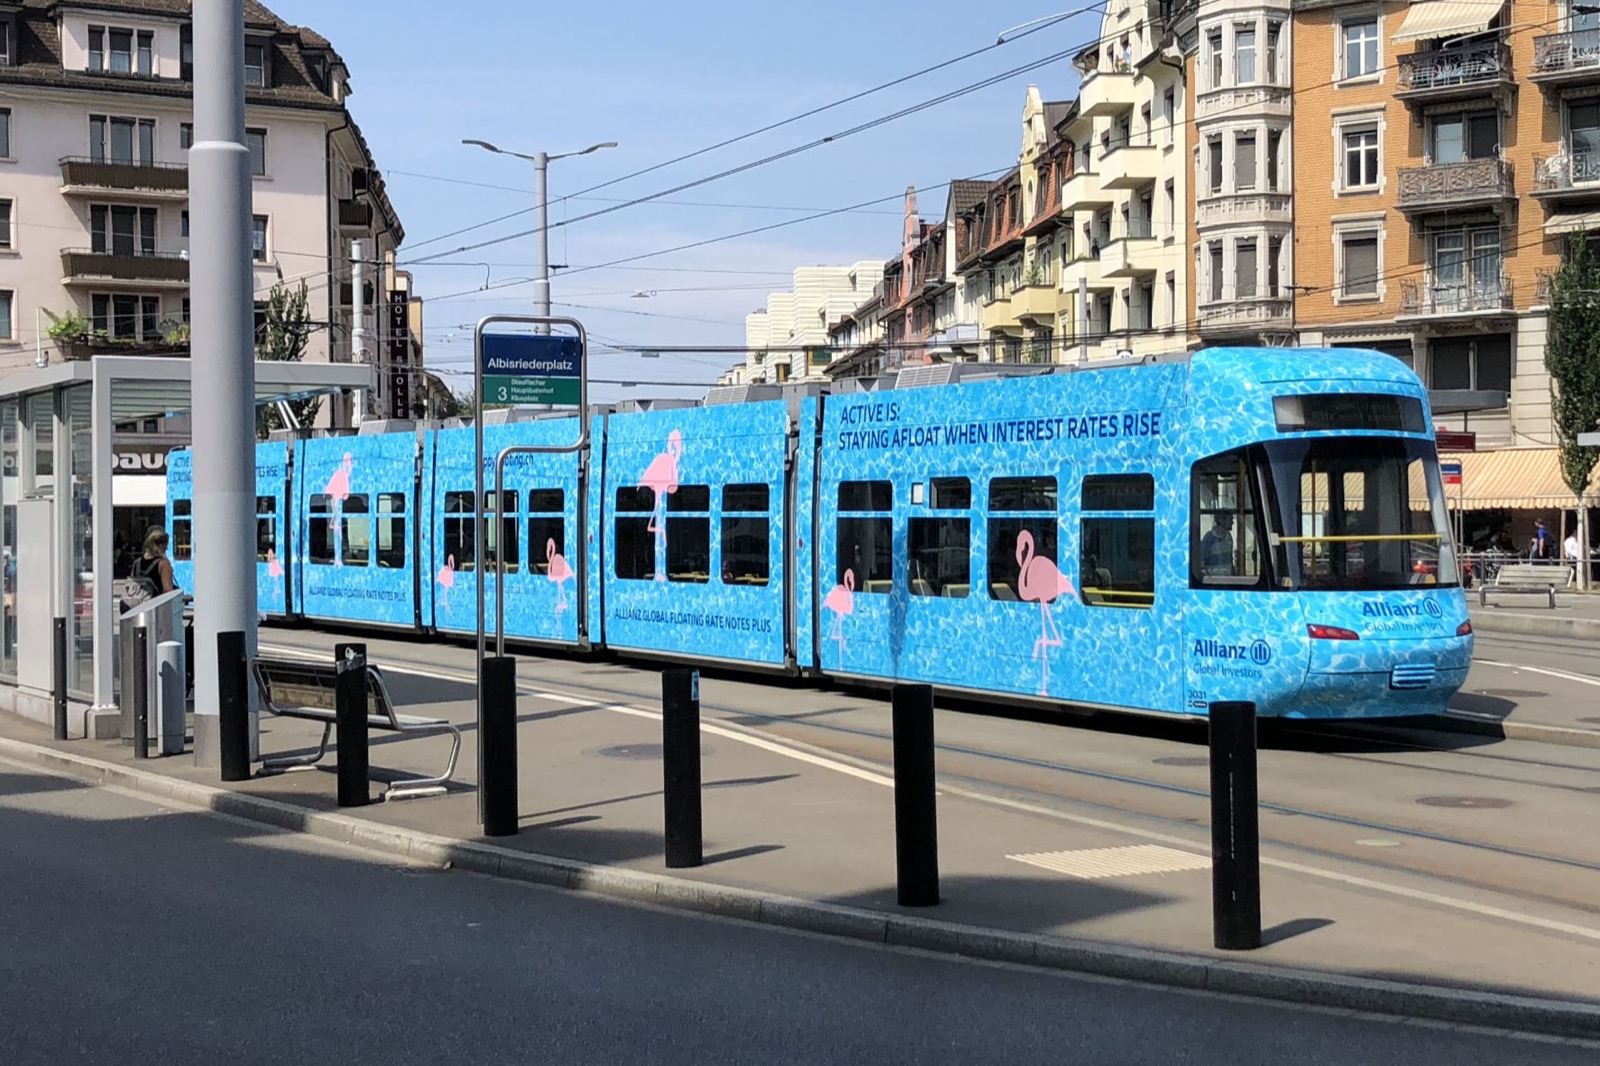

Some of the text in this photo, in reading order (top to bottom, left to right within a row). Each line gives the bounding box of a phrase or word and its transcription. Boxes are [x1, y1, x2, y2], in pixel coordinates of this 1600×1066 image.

[394, 295, 403, 348] HOTEL
[487, 357, 573, 372] Albisriederplatz
[497, 386, 508, 401] 3
[840, 402, 901, 425] ACTIVE IS:
[838, 412, 1161, 450] STAYING AFLOAT WHEN INTEREST RATES RISE
[1362, 601, 1423, 617] Allianz
[615, 608, 772, 632] ALLIANZ GLOBAL FLOATING RATE NOTES PLUS
[1365, 621, 1400, 632] Global
[1194, 639, 1247, 660] Allianz
[1193, 662, 1263, 679] Global Investors
[1187, 689, 1207, 699] 3031
